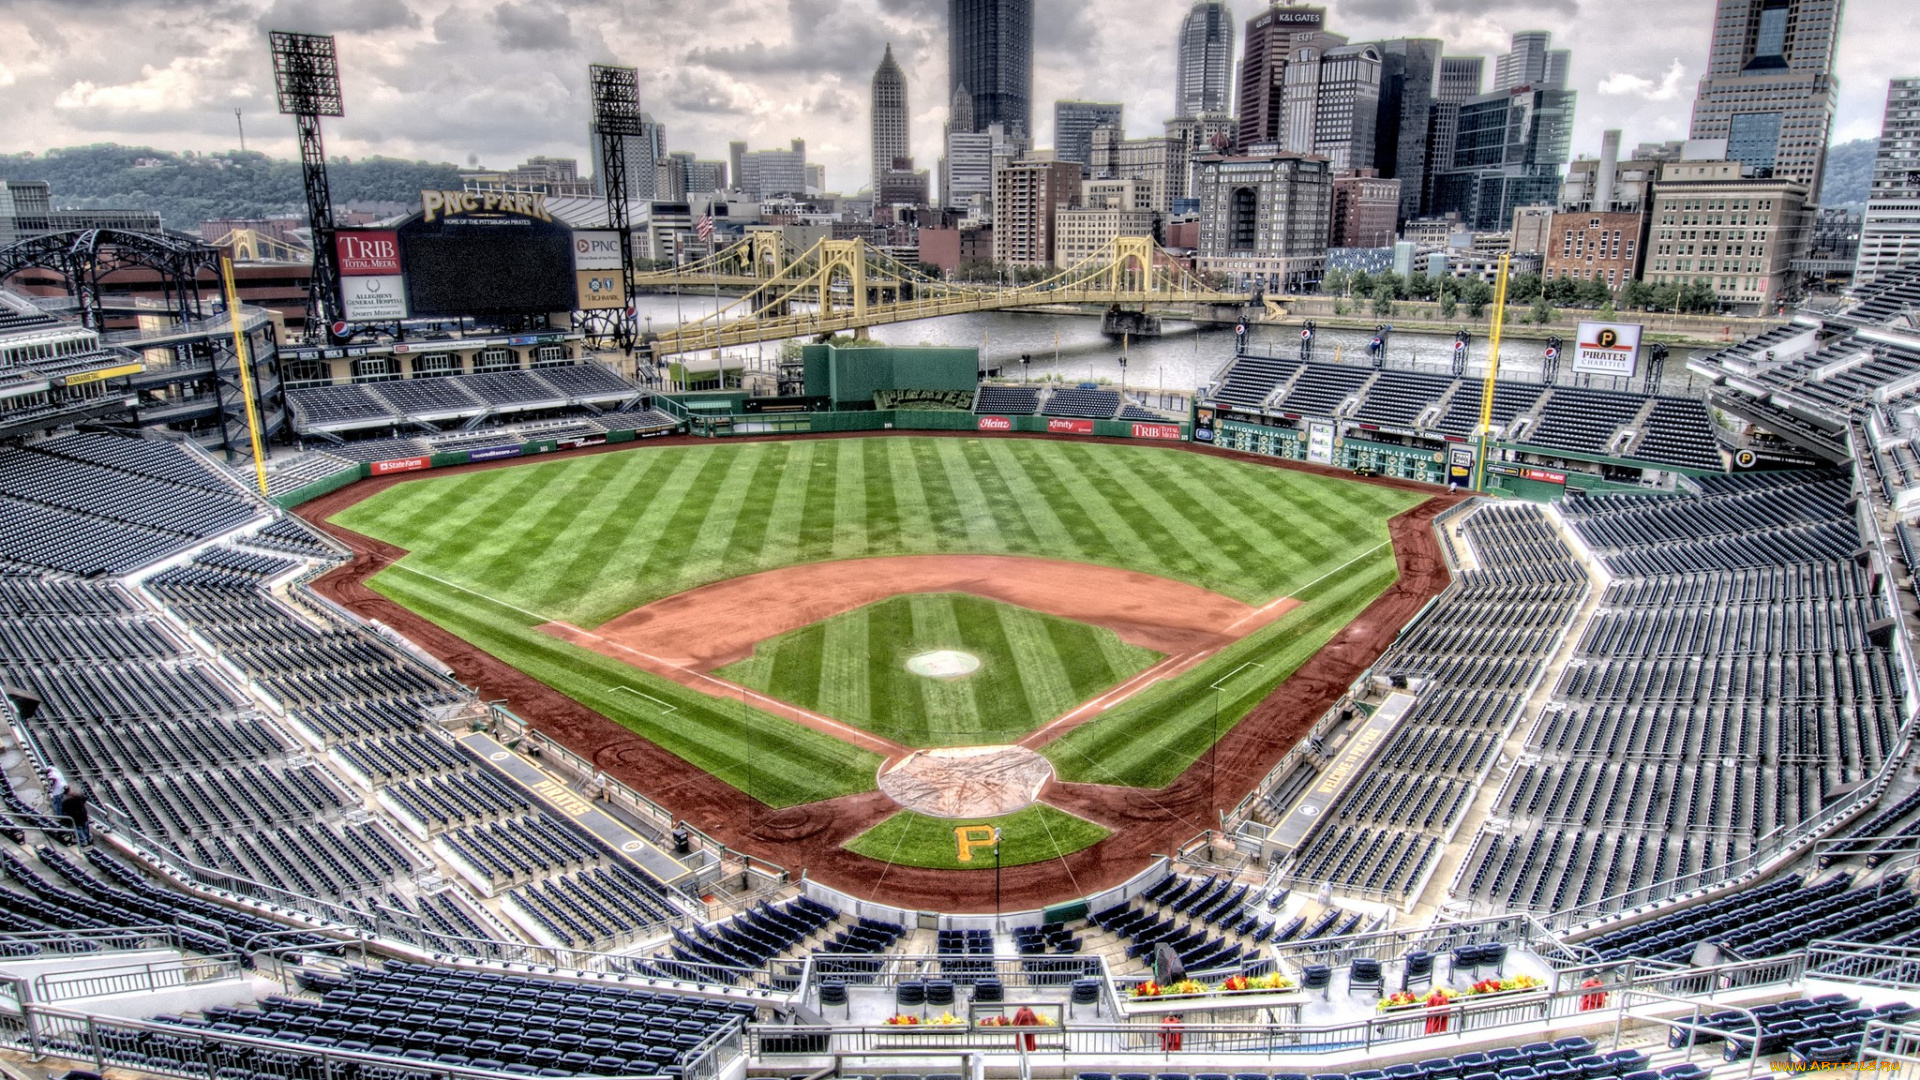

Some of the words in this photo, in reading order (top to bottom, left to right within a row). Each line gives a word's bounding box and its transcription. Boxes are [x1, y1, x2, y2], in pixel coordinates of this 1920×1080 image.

[1295, 14, 1320, 22] GATES
[421, 189, 478, 223] PNC
[483, 191, 552, 223] PARK
[339, 237, 396, 258] TRIB
[591, 240, 618, 252] PNC
[343, 259, 371, 268] TOTAL
[371, 259, 398, 268] MEDIA
[1602, 332, 1613, 346] P
[1582, 350, 1626, 362] PIRATES
[1581, 359, 1626, 368] CHARITIES
[68, 372, 100, 384] KENNAMETAL
[881, 389, 975, 408] PIRATES
[980, 419, 1009, 428] Heinz
[1050, 420, 1073, 430] xfinity
[1133, 424, 1159, 437] TRIB
[1223, 425, 1263, 435] NATIONAL
[1266, 431, 1296, 440] LEAGUE
[1312, 438, 1328, 446] FedEx
[1311, 450, 1328, 458] FedEx
[1344, 444, 1392, 455] AMERICAN
[1395, 451, 1432, 461] LEAGUE
[1742, 453, 1751, 463] P
[1317, 761, 1354, 794] WELCOME
[1349, 742, 1370, 758] PNC
[1360, 728, 1382, 745] PARK
[531, 779, 593, 817] PIRATES
[953, 825, 996, 862] P
